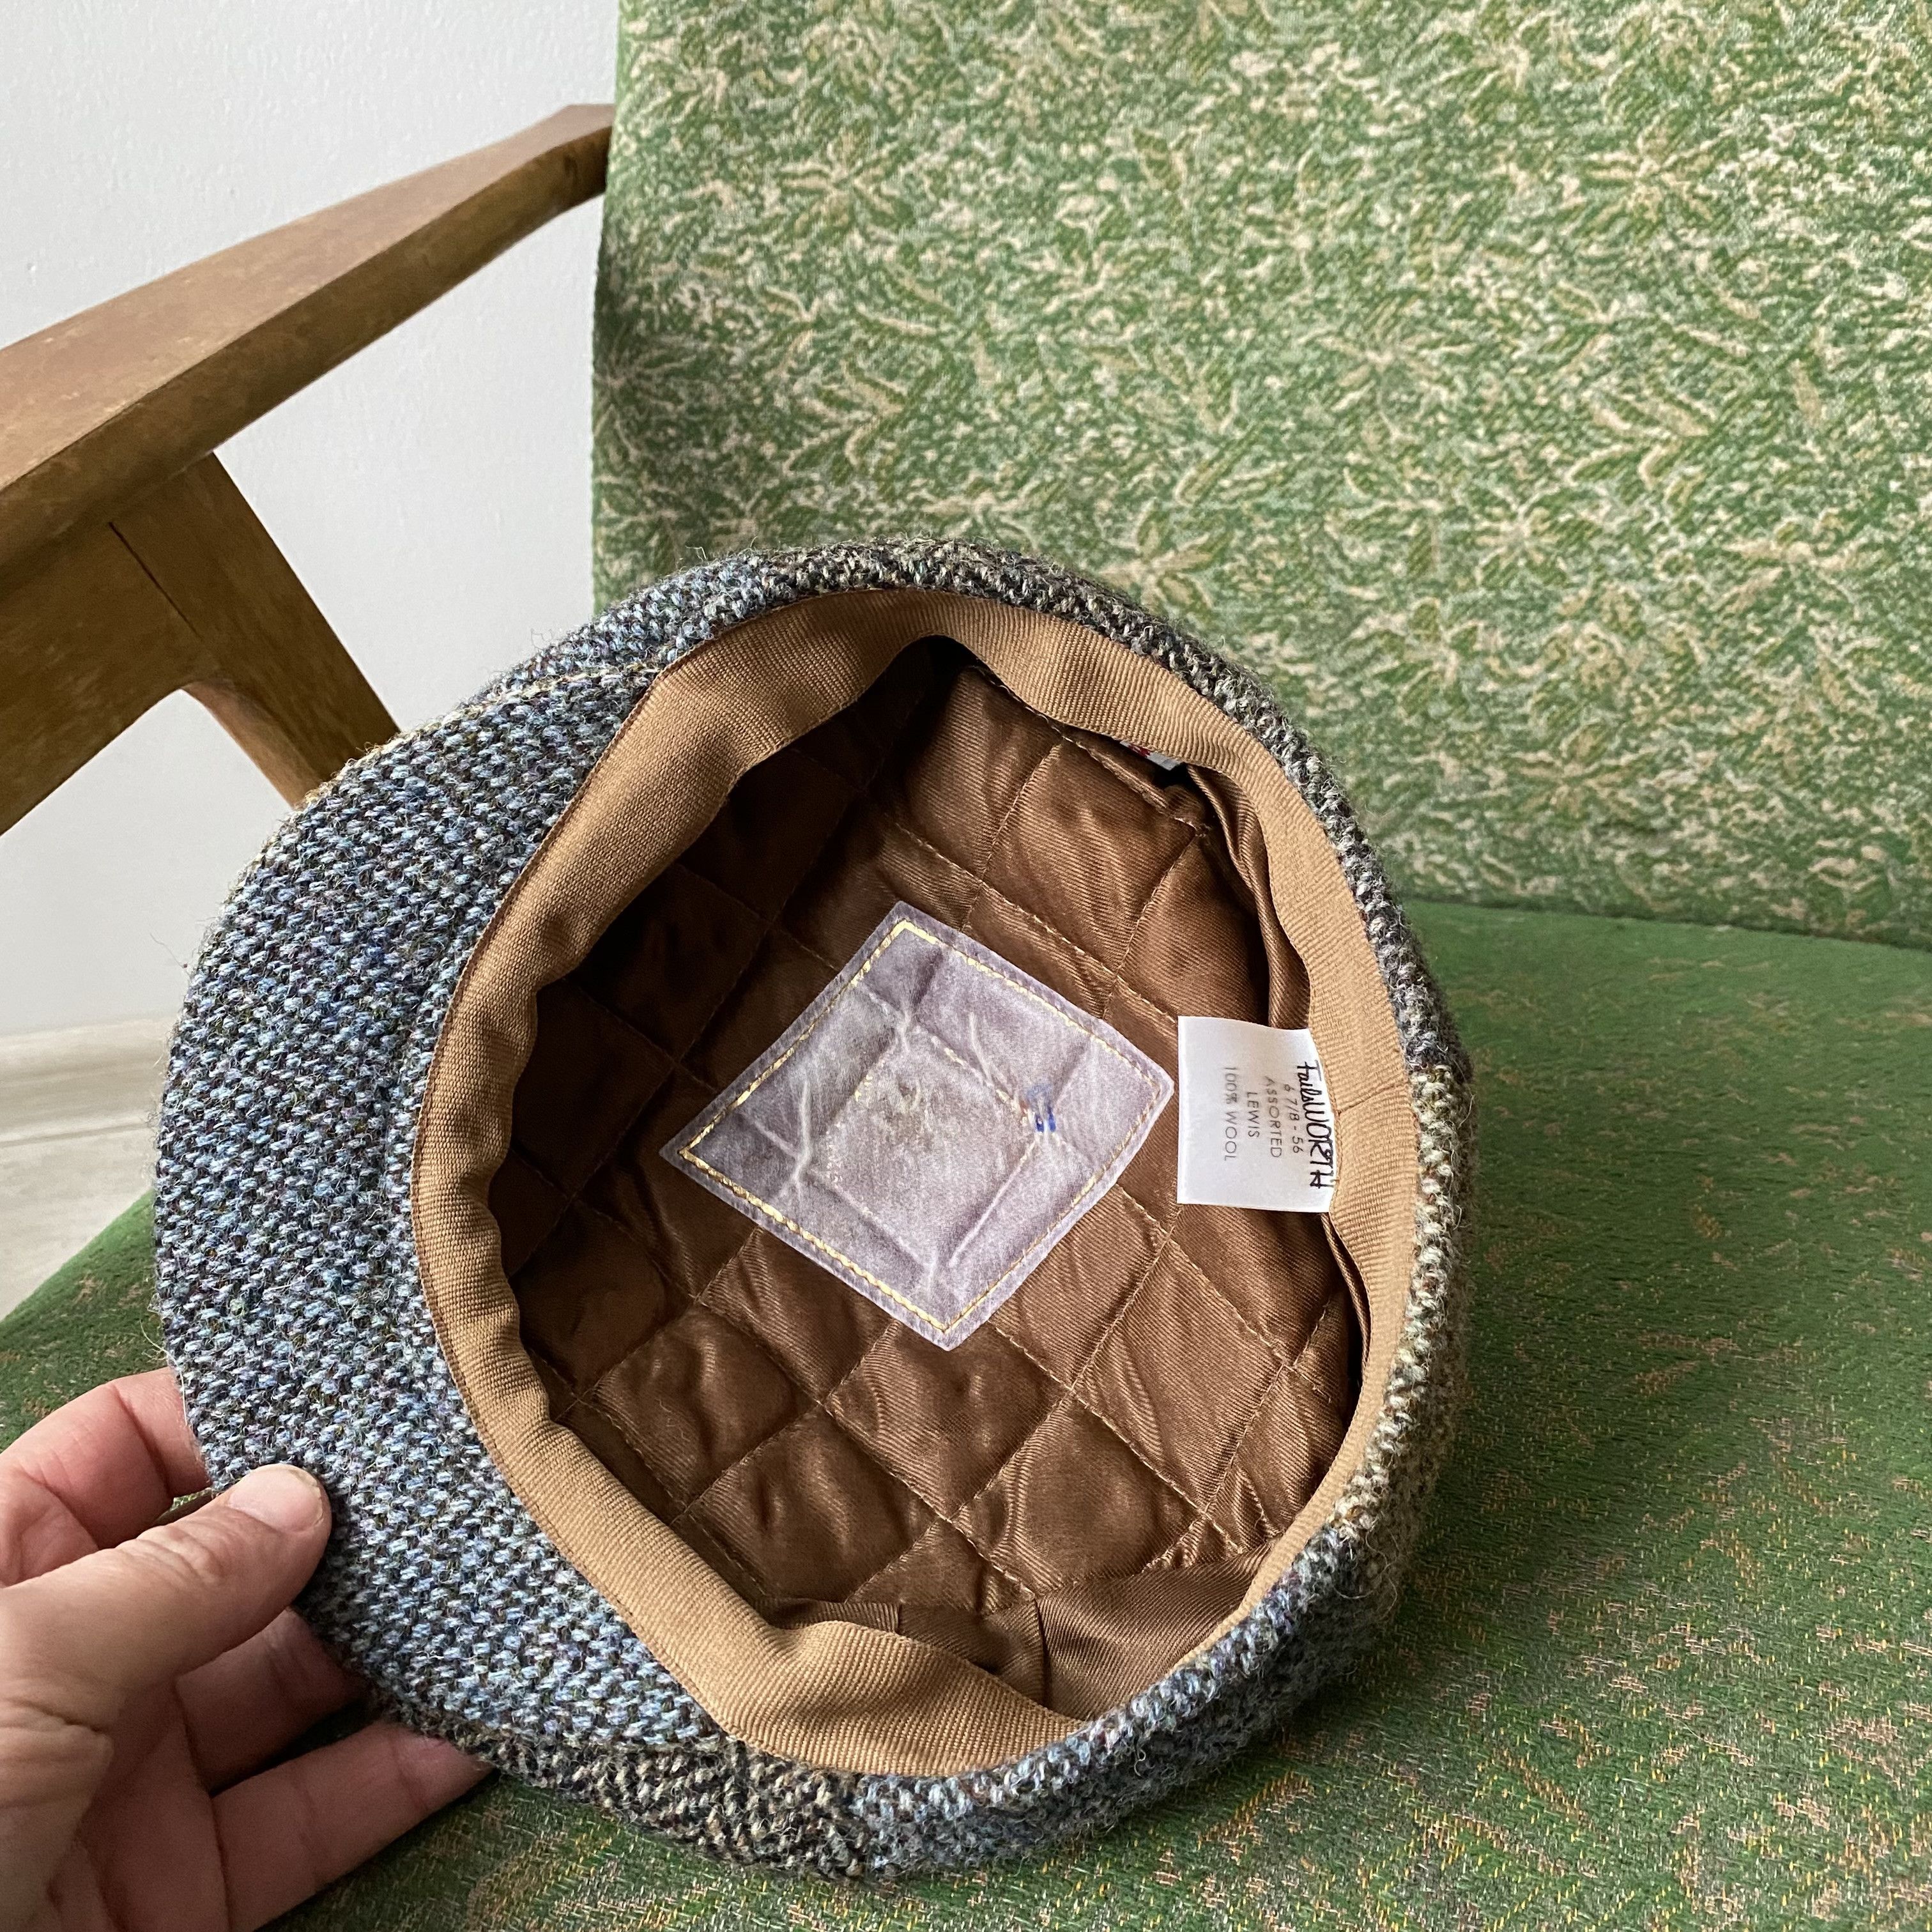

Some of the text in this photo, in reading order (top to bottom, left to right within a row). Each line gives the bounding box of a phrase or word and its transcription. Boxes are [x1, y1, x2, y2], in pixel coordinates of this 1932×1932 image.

[1225, 1067, 1238, 1161] 100% WOOL
[1247, 1092, 1260, 1138] LEWIS
[1264, 1076, 1282, 1158] ASSORTED
[1285, 1098, 1300, 1121] 7/8
[1292, 1136, 1303, 1153] 56
